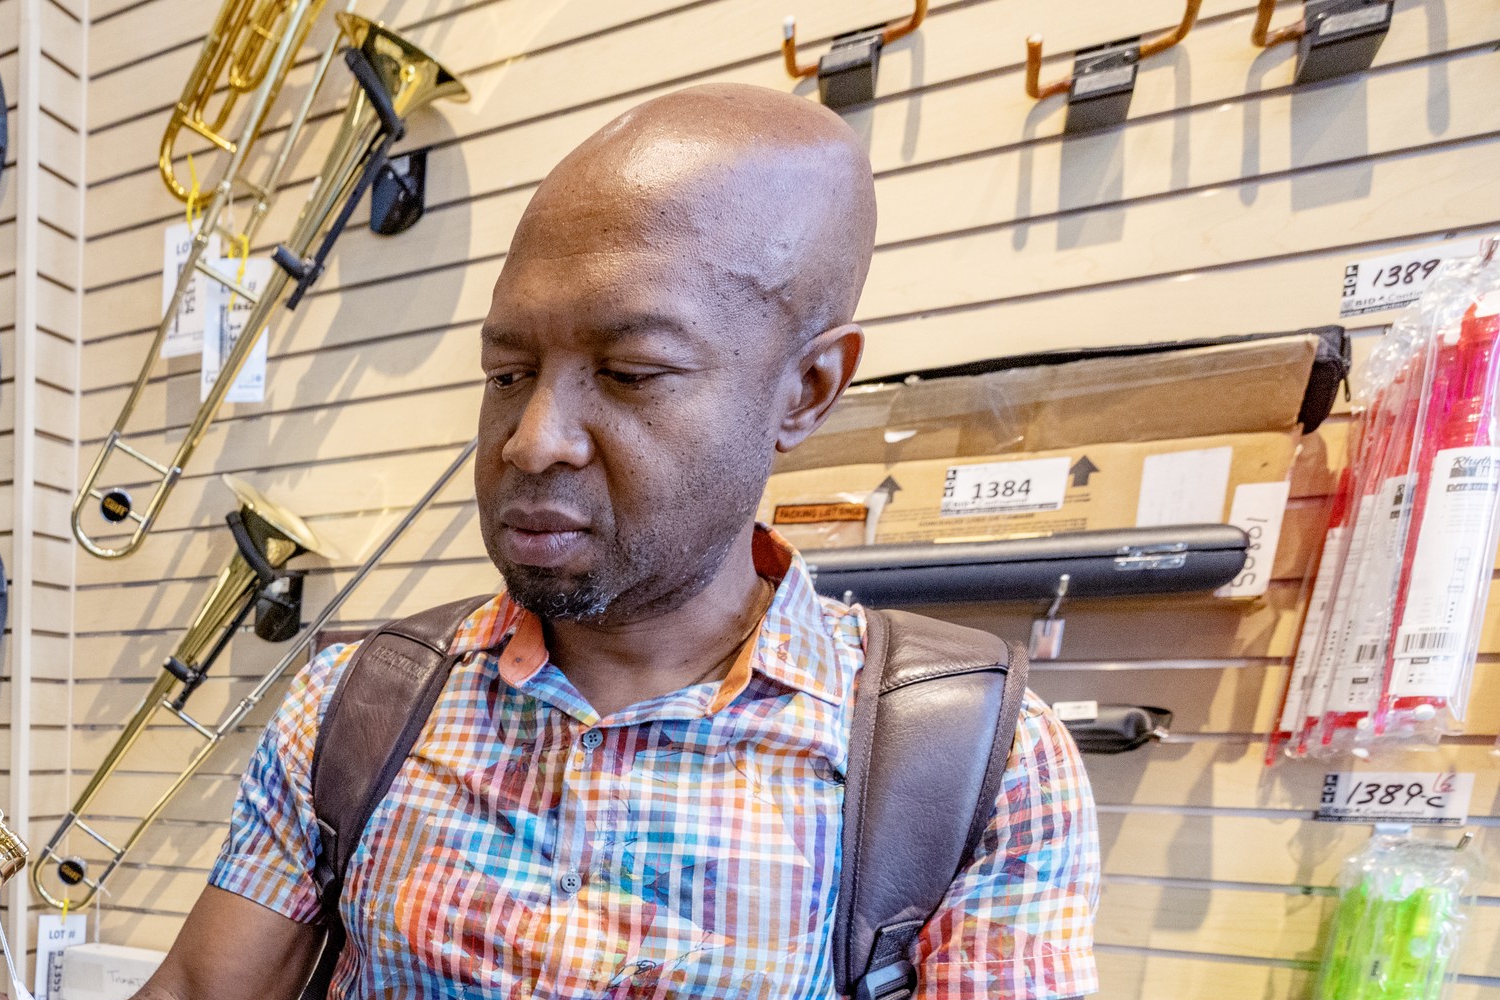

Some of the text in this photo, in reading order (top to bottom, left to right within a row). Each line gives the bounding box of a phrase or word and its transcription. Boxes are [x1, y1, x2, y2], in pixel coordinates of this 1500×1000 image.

[1372, 258, 1441, 288] 1389
[971, 478, 1032, 500] 1384
[49, 930, 76, 939] LOT #
